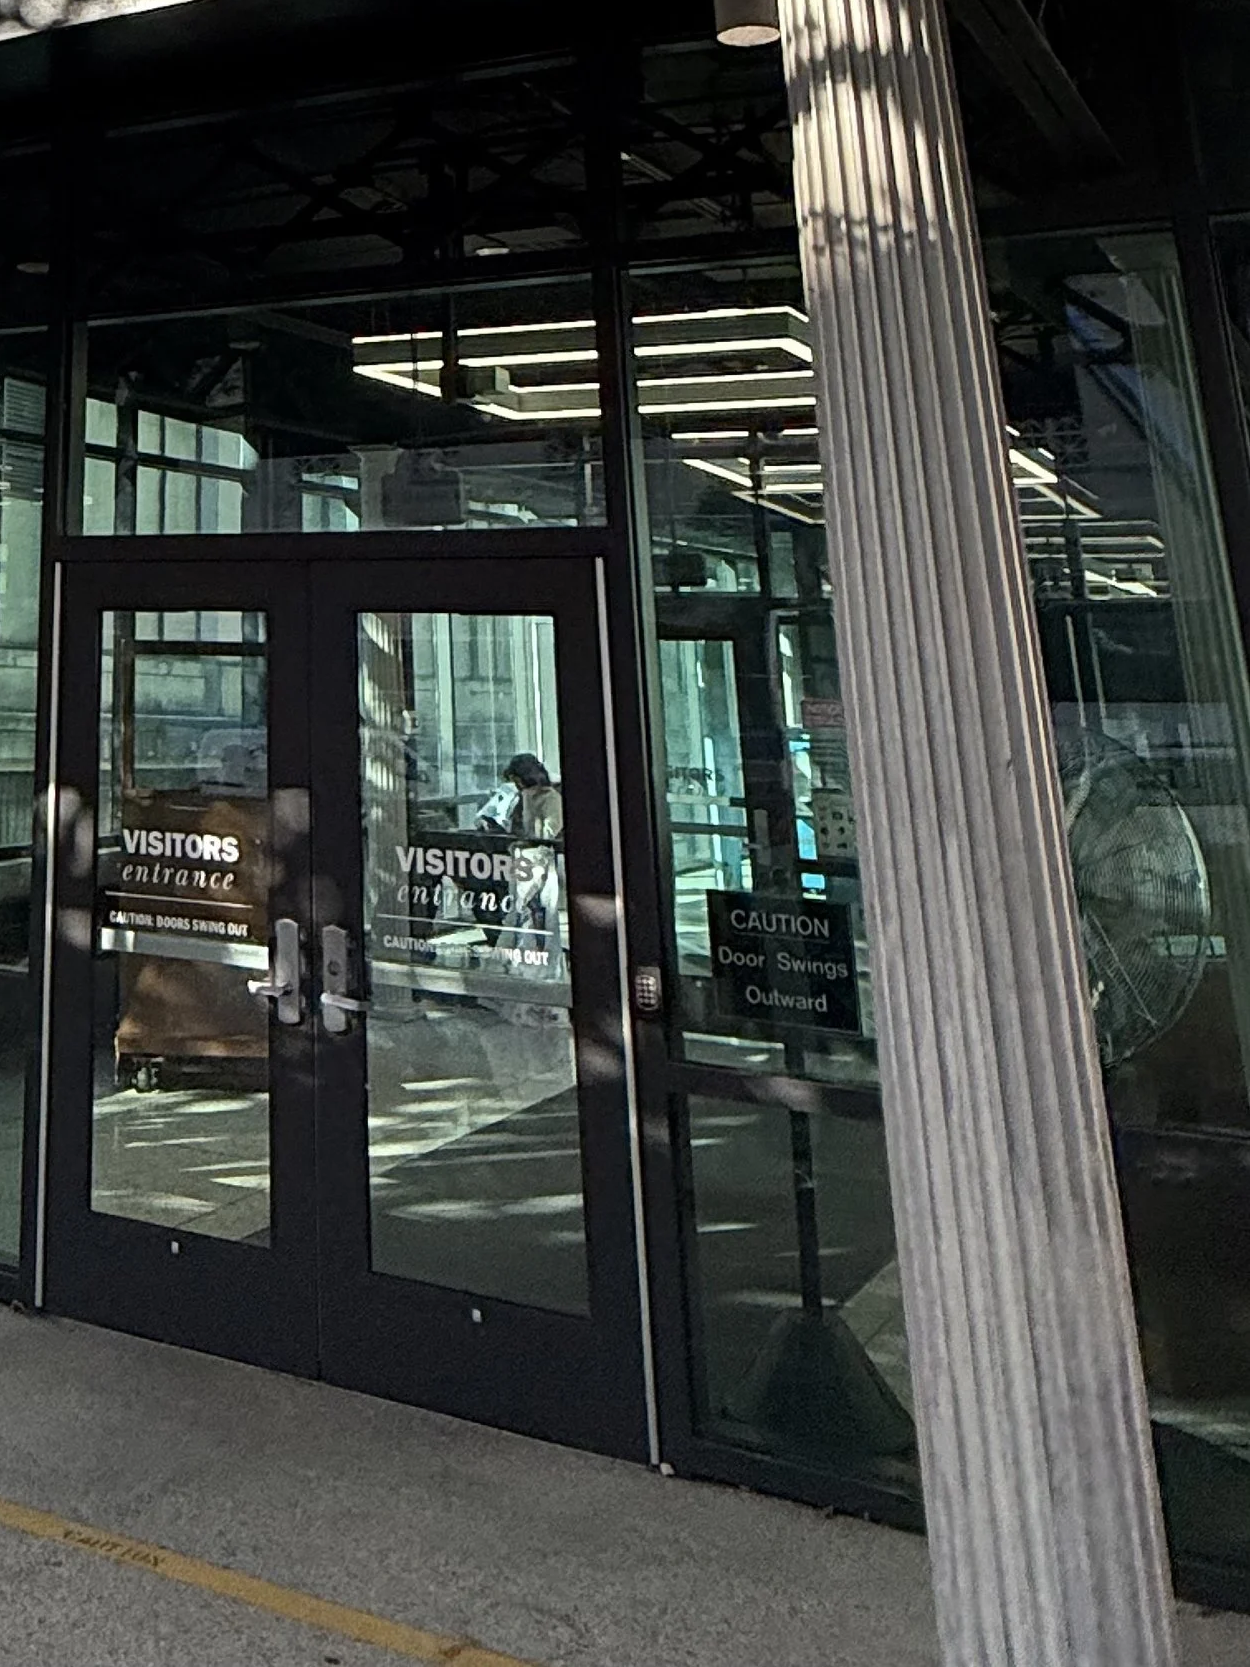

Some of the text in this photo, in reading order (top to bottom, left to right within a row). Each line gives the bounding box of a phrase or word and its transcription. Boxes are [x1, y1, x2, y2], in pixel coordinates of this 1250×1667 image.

[122, 829, 240, 863] VISITORS
[122, 862, 235, 890] entrance
[395, 846, 534, 882] VISITORS
[397, 883, 530, 914] entrance
[156, 915, 190, 930] DOORS
[192, 919, 225, 935] SWING
[227, 923, 248, 937] OUT
[730, 909, 830, 938] CAUTION
[524, 950, 549, 966] OUT
[718, 945, 849, 980] Door Swings
[745, 986, 828, 1012] Outward
